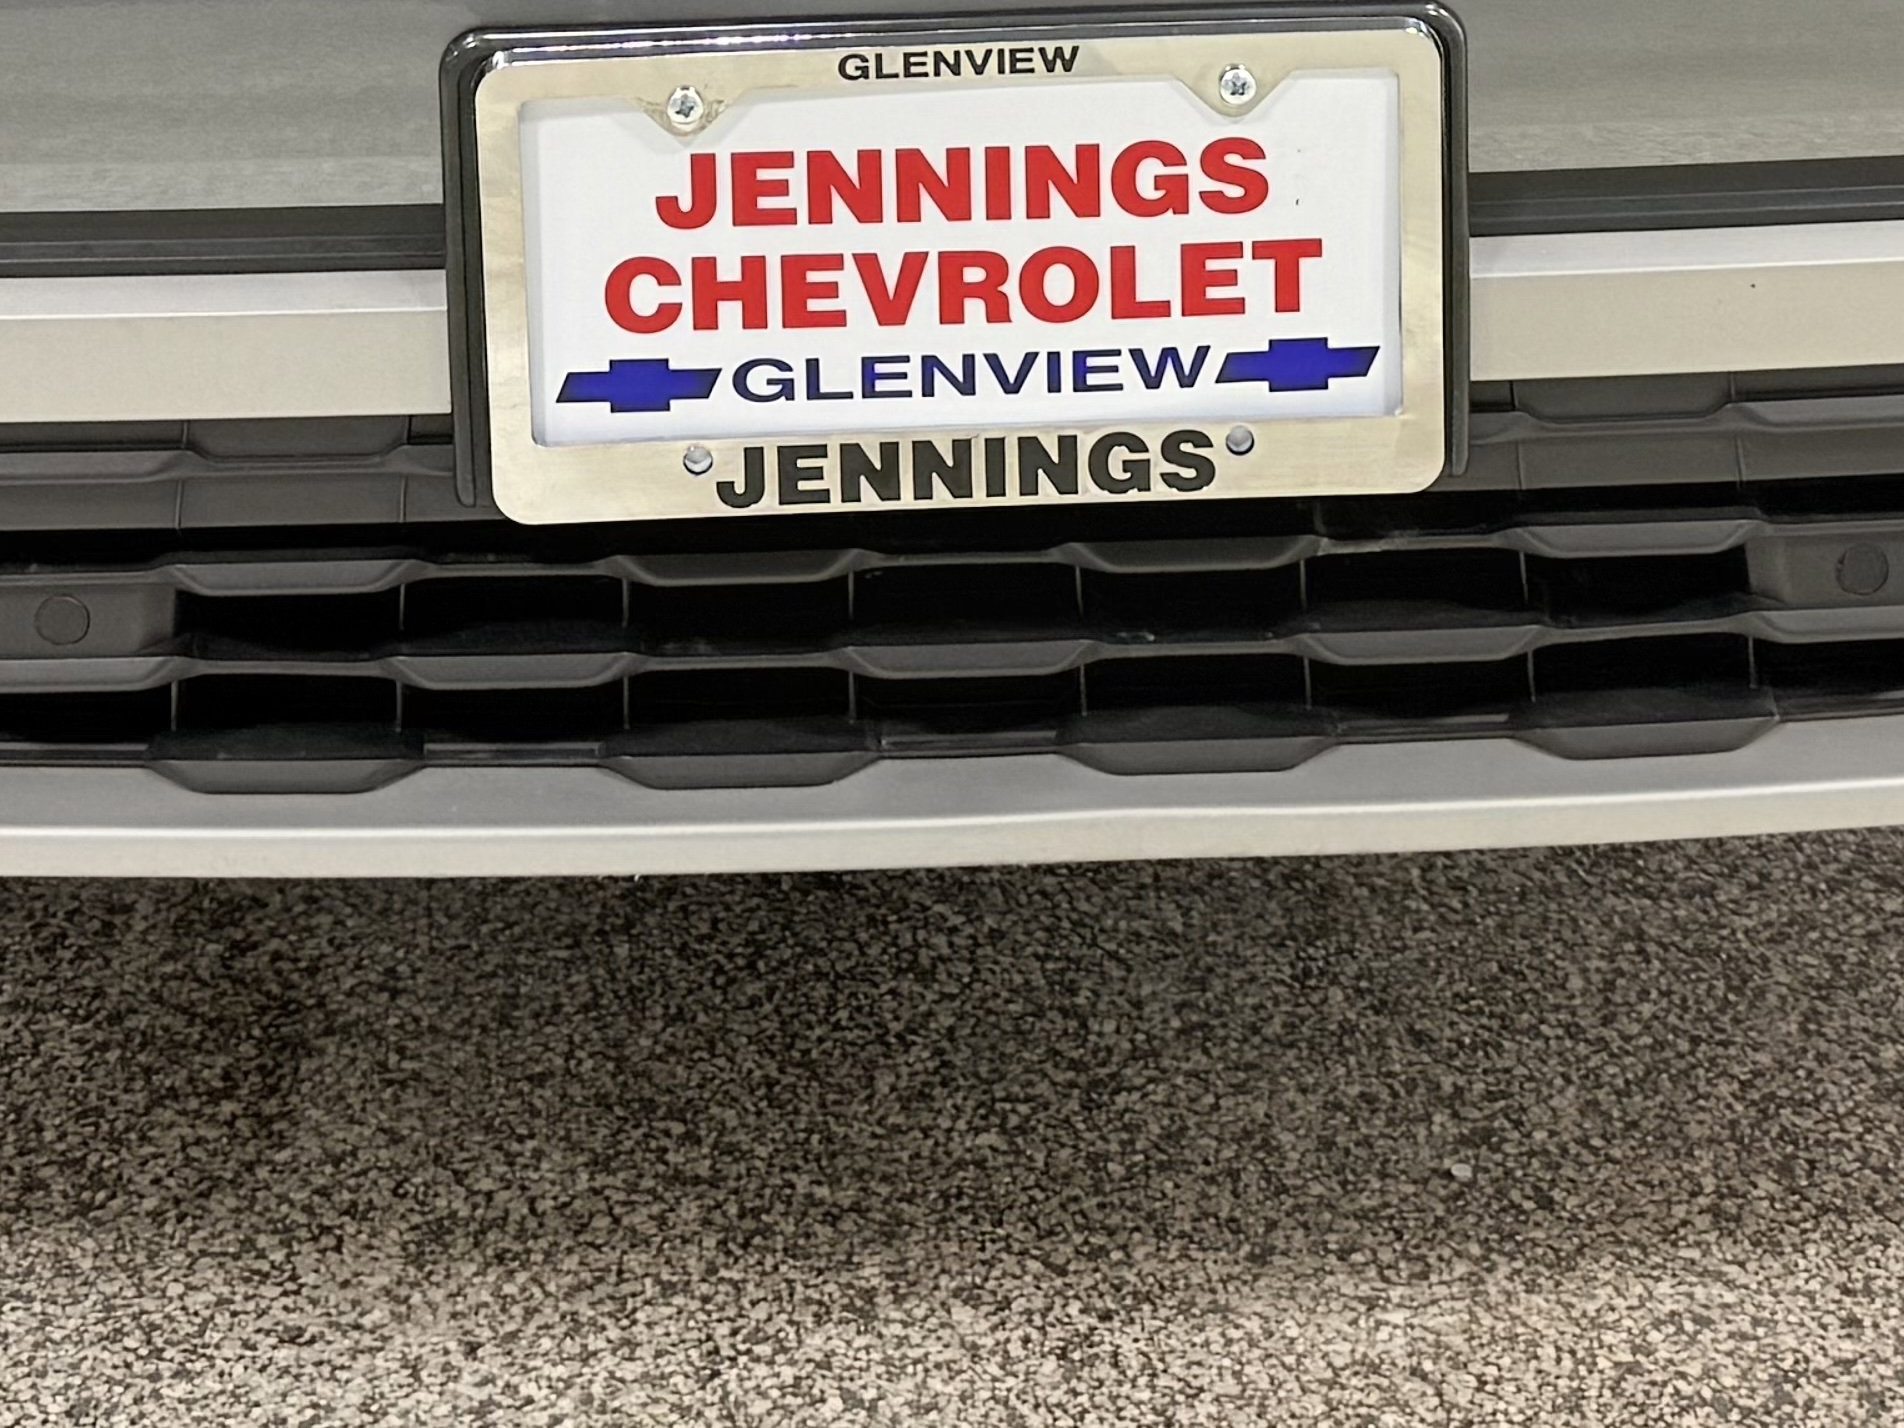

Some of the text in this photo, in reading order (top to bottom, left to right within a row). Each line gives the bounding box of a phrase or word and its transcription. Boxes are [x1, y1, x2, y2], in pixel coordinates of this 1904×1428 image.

[837, 45, 1081, 81] GLENVIEW
[655, 137, 1269, 230] JENNINGS
[604, 238, 1323, 334] CHEVROLET
[731, 344, 1212, 403] GLENVIEW
[715, 429, 1216, 509] JENNINGS
